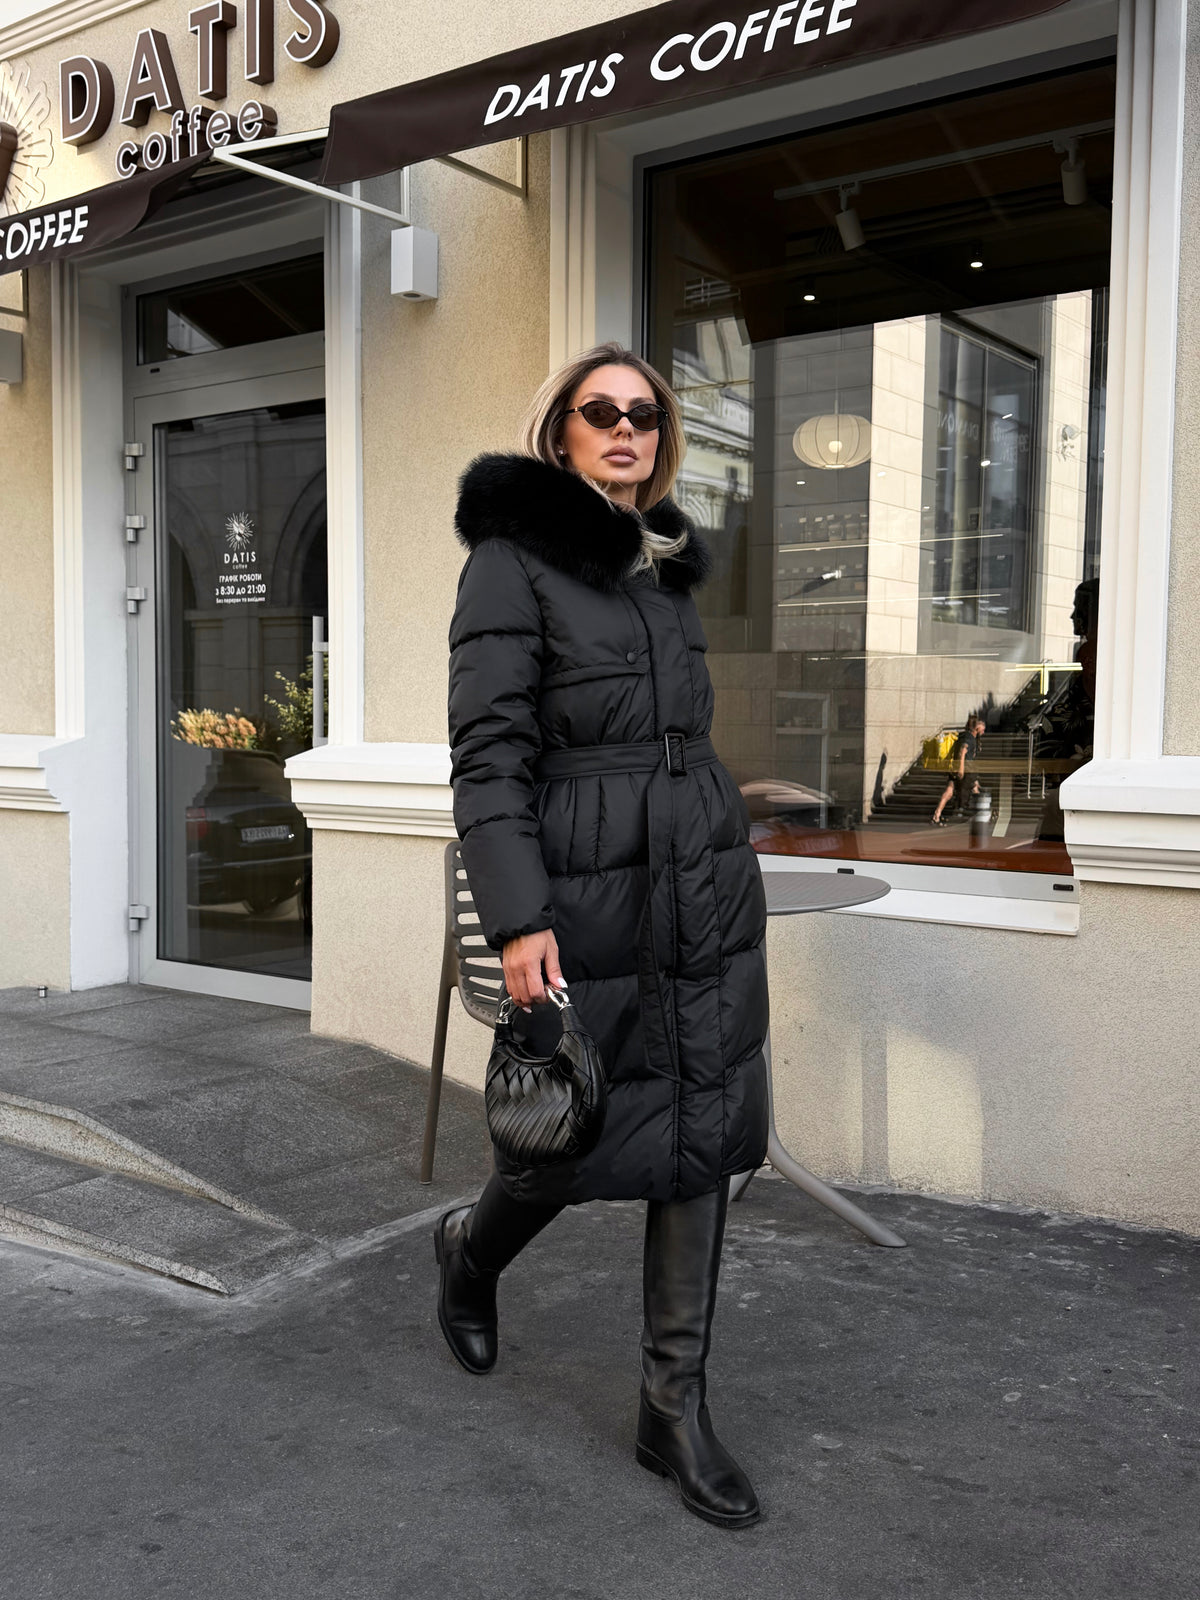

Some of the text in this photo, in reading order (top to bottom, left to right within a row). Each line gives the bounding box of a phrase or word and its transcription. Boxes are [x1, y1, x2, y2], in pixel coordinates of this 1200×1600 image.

[59, 0, 338, 145] DATIS
[484, 0, 858, 126] DATIS COFFEE
[115, 99, 270, 179] coffee
[224, 551, 256, 564] DATIS
[239, 573, 262, 582] РОБОТИ
[220, 586, 235, 595] 8:30
[247, 584, 266, 594] 21:00
